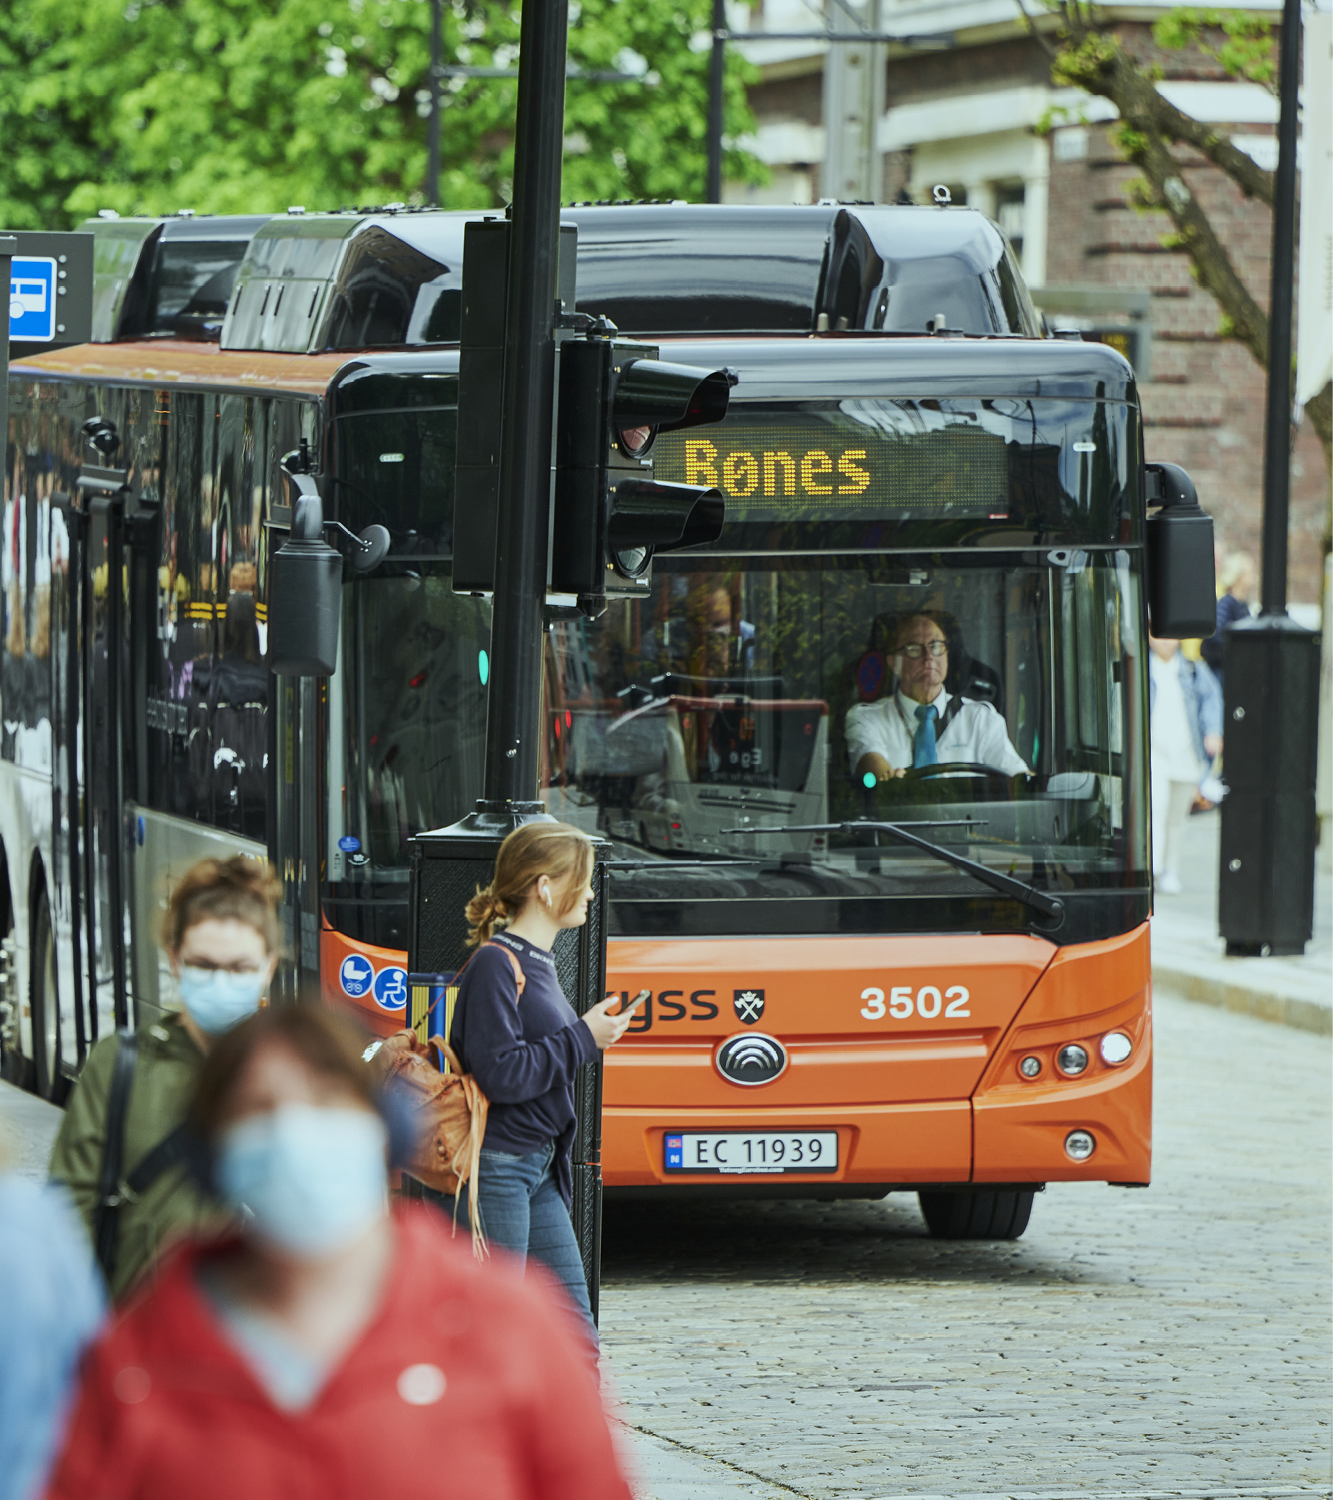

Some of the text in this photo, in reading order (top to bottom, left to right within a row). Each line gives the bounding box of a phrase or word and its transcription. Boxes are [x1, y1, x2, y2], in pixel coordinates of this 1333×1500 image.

[606, 990, 719, 1033] yss
[859, 985, 971, 1021] 3502
[696, 1138, 822, 1163] EC 11939
